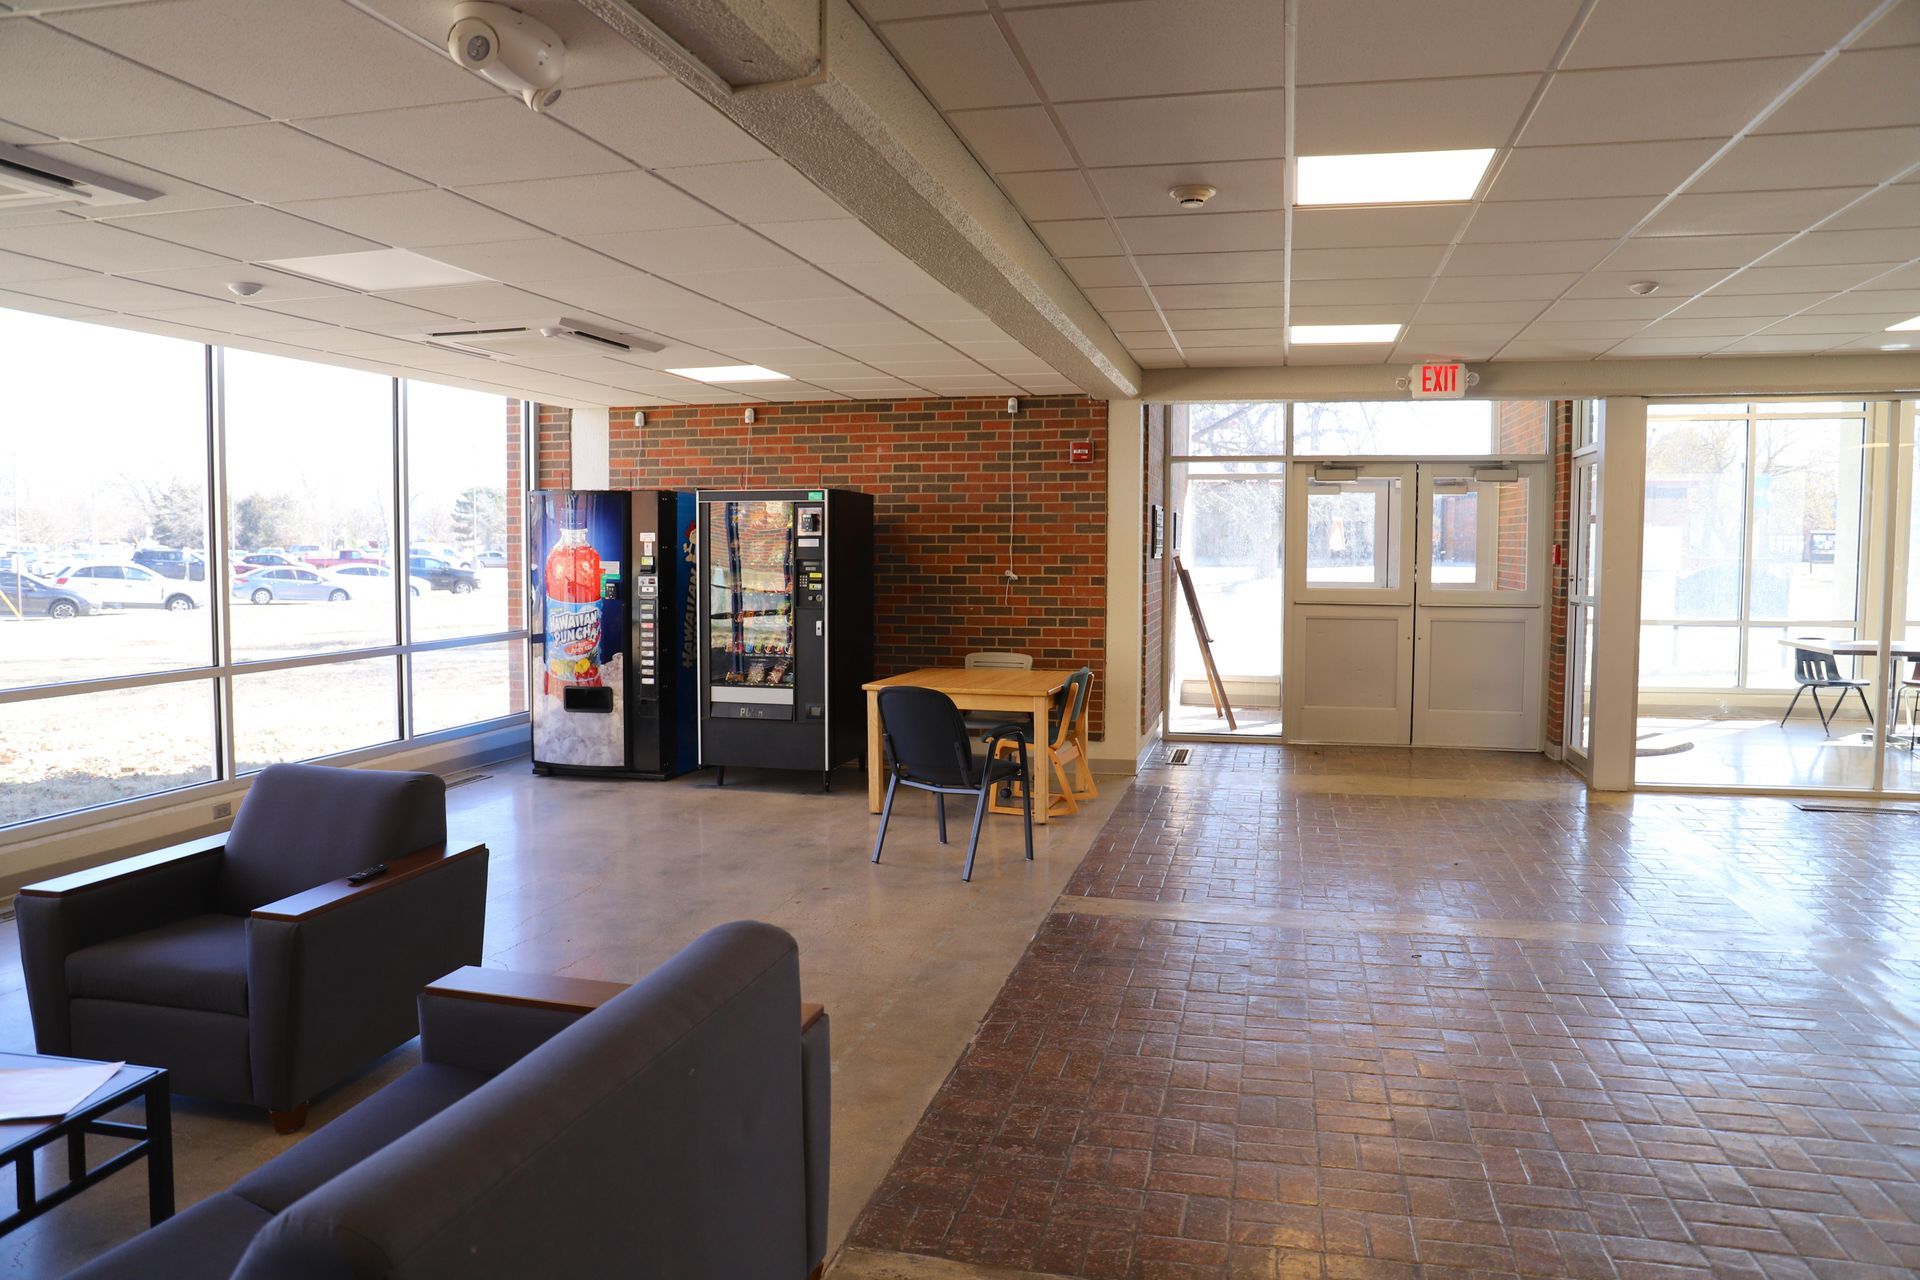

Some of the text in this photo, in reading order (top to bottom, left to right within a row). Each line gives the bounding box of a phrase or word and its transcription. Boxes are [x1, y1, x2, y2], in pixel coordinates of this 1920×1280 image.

[1422, 365, 1459, 392] EXIT
[549, 609, 598, 632] HAWAIIAN
[553, 624, 593, 648] PUNCH
